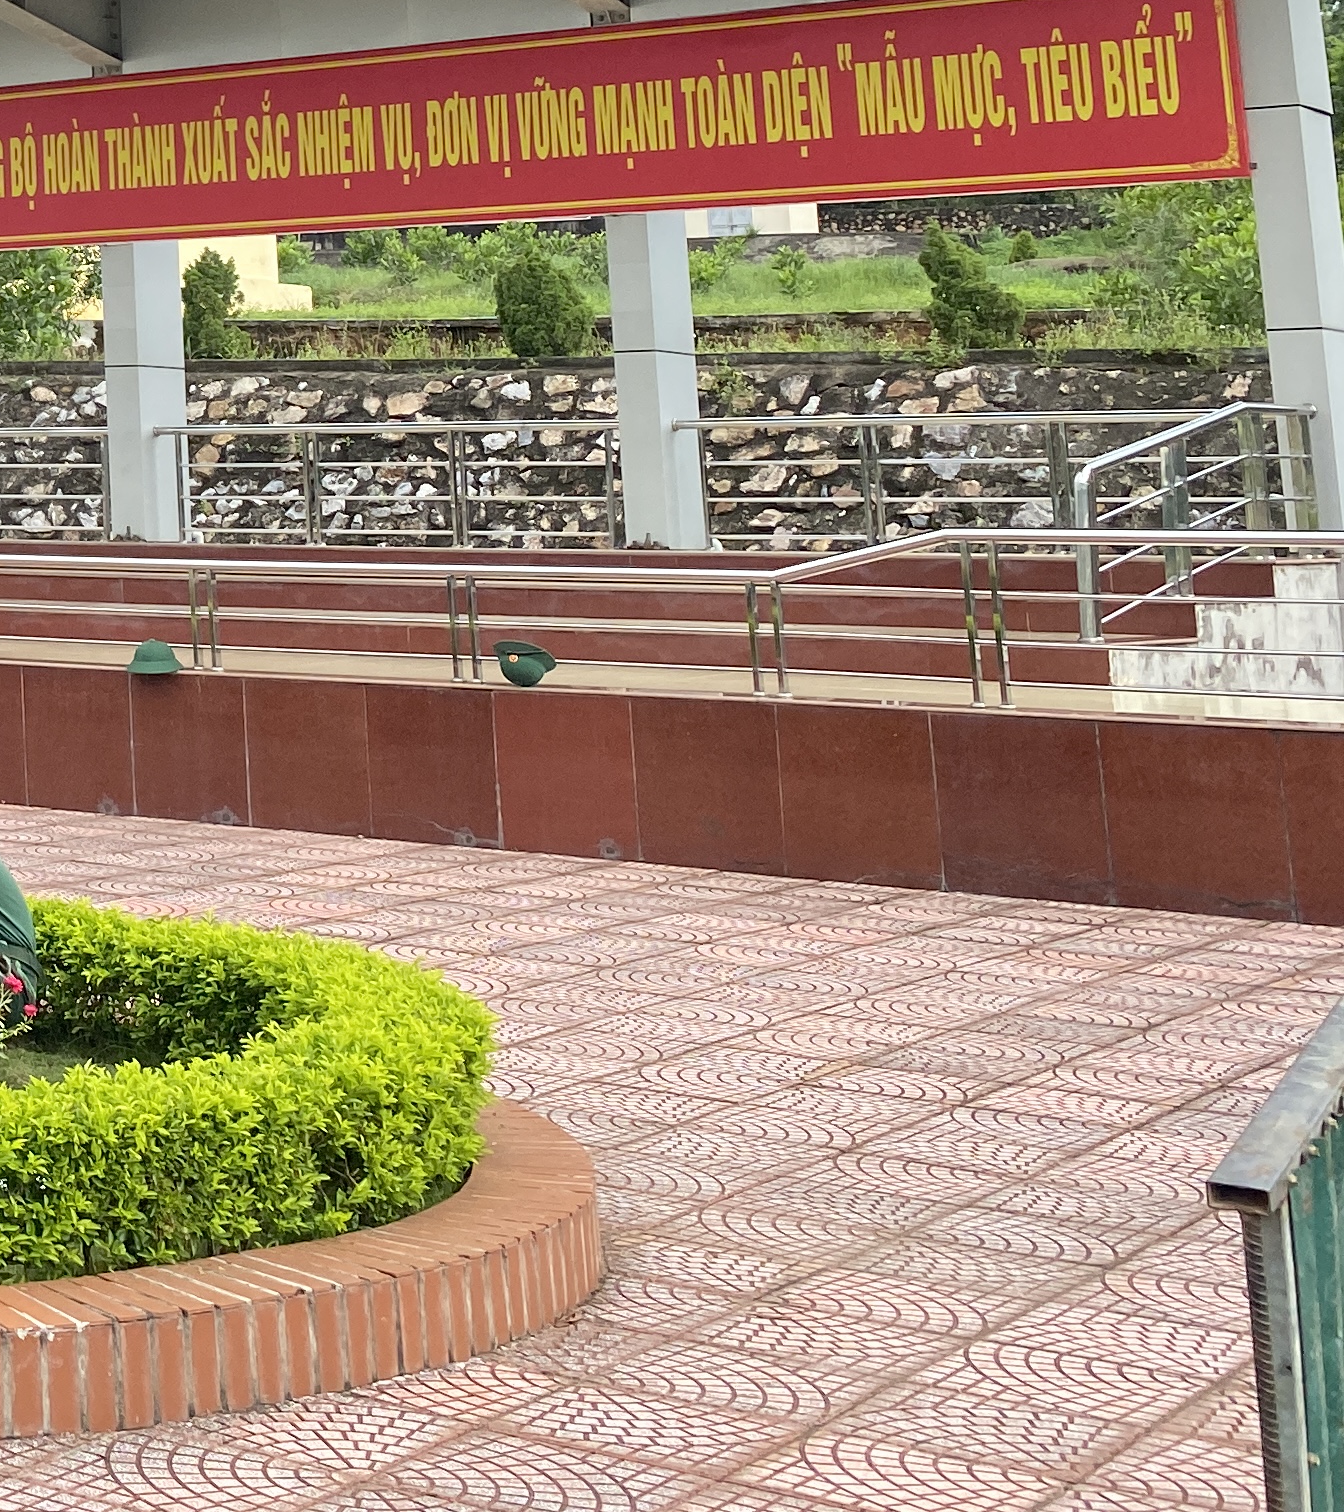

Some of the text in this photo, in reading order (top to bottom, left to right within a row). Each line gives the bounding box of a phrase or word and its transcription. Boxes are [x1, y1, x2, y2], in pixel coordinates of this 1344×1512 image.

[10, 122, 37, 210] BỘ
[42, 118, 100, 195] HOÀN
[104, 112, 176, 190] THÀNH
[181, 94, 238, 185] XUẤT
[245, 88, 291, 181] SẮC
[297, 93, 375, 189] NHIỆM
[380, 102, 421, 185] VỤ,
[426, 91, 480, 167] ĐƠN
[484, 94, 511, 178] VỊ
[515, 76, 588, 161] VỮNG
[592, 79, 676, 170] MẠNH
[680, 59, 757, 148] TOÀN
[761, 51, 833, 158] DIỆN
[931, 43, 1016, 146] MỰC,
[1020, 27, 1093, 124] TIÊU
